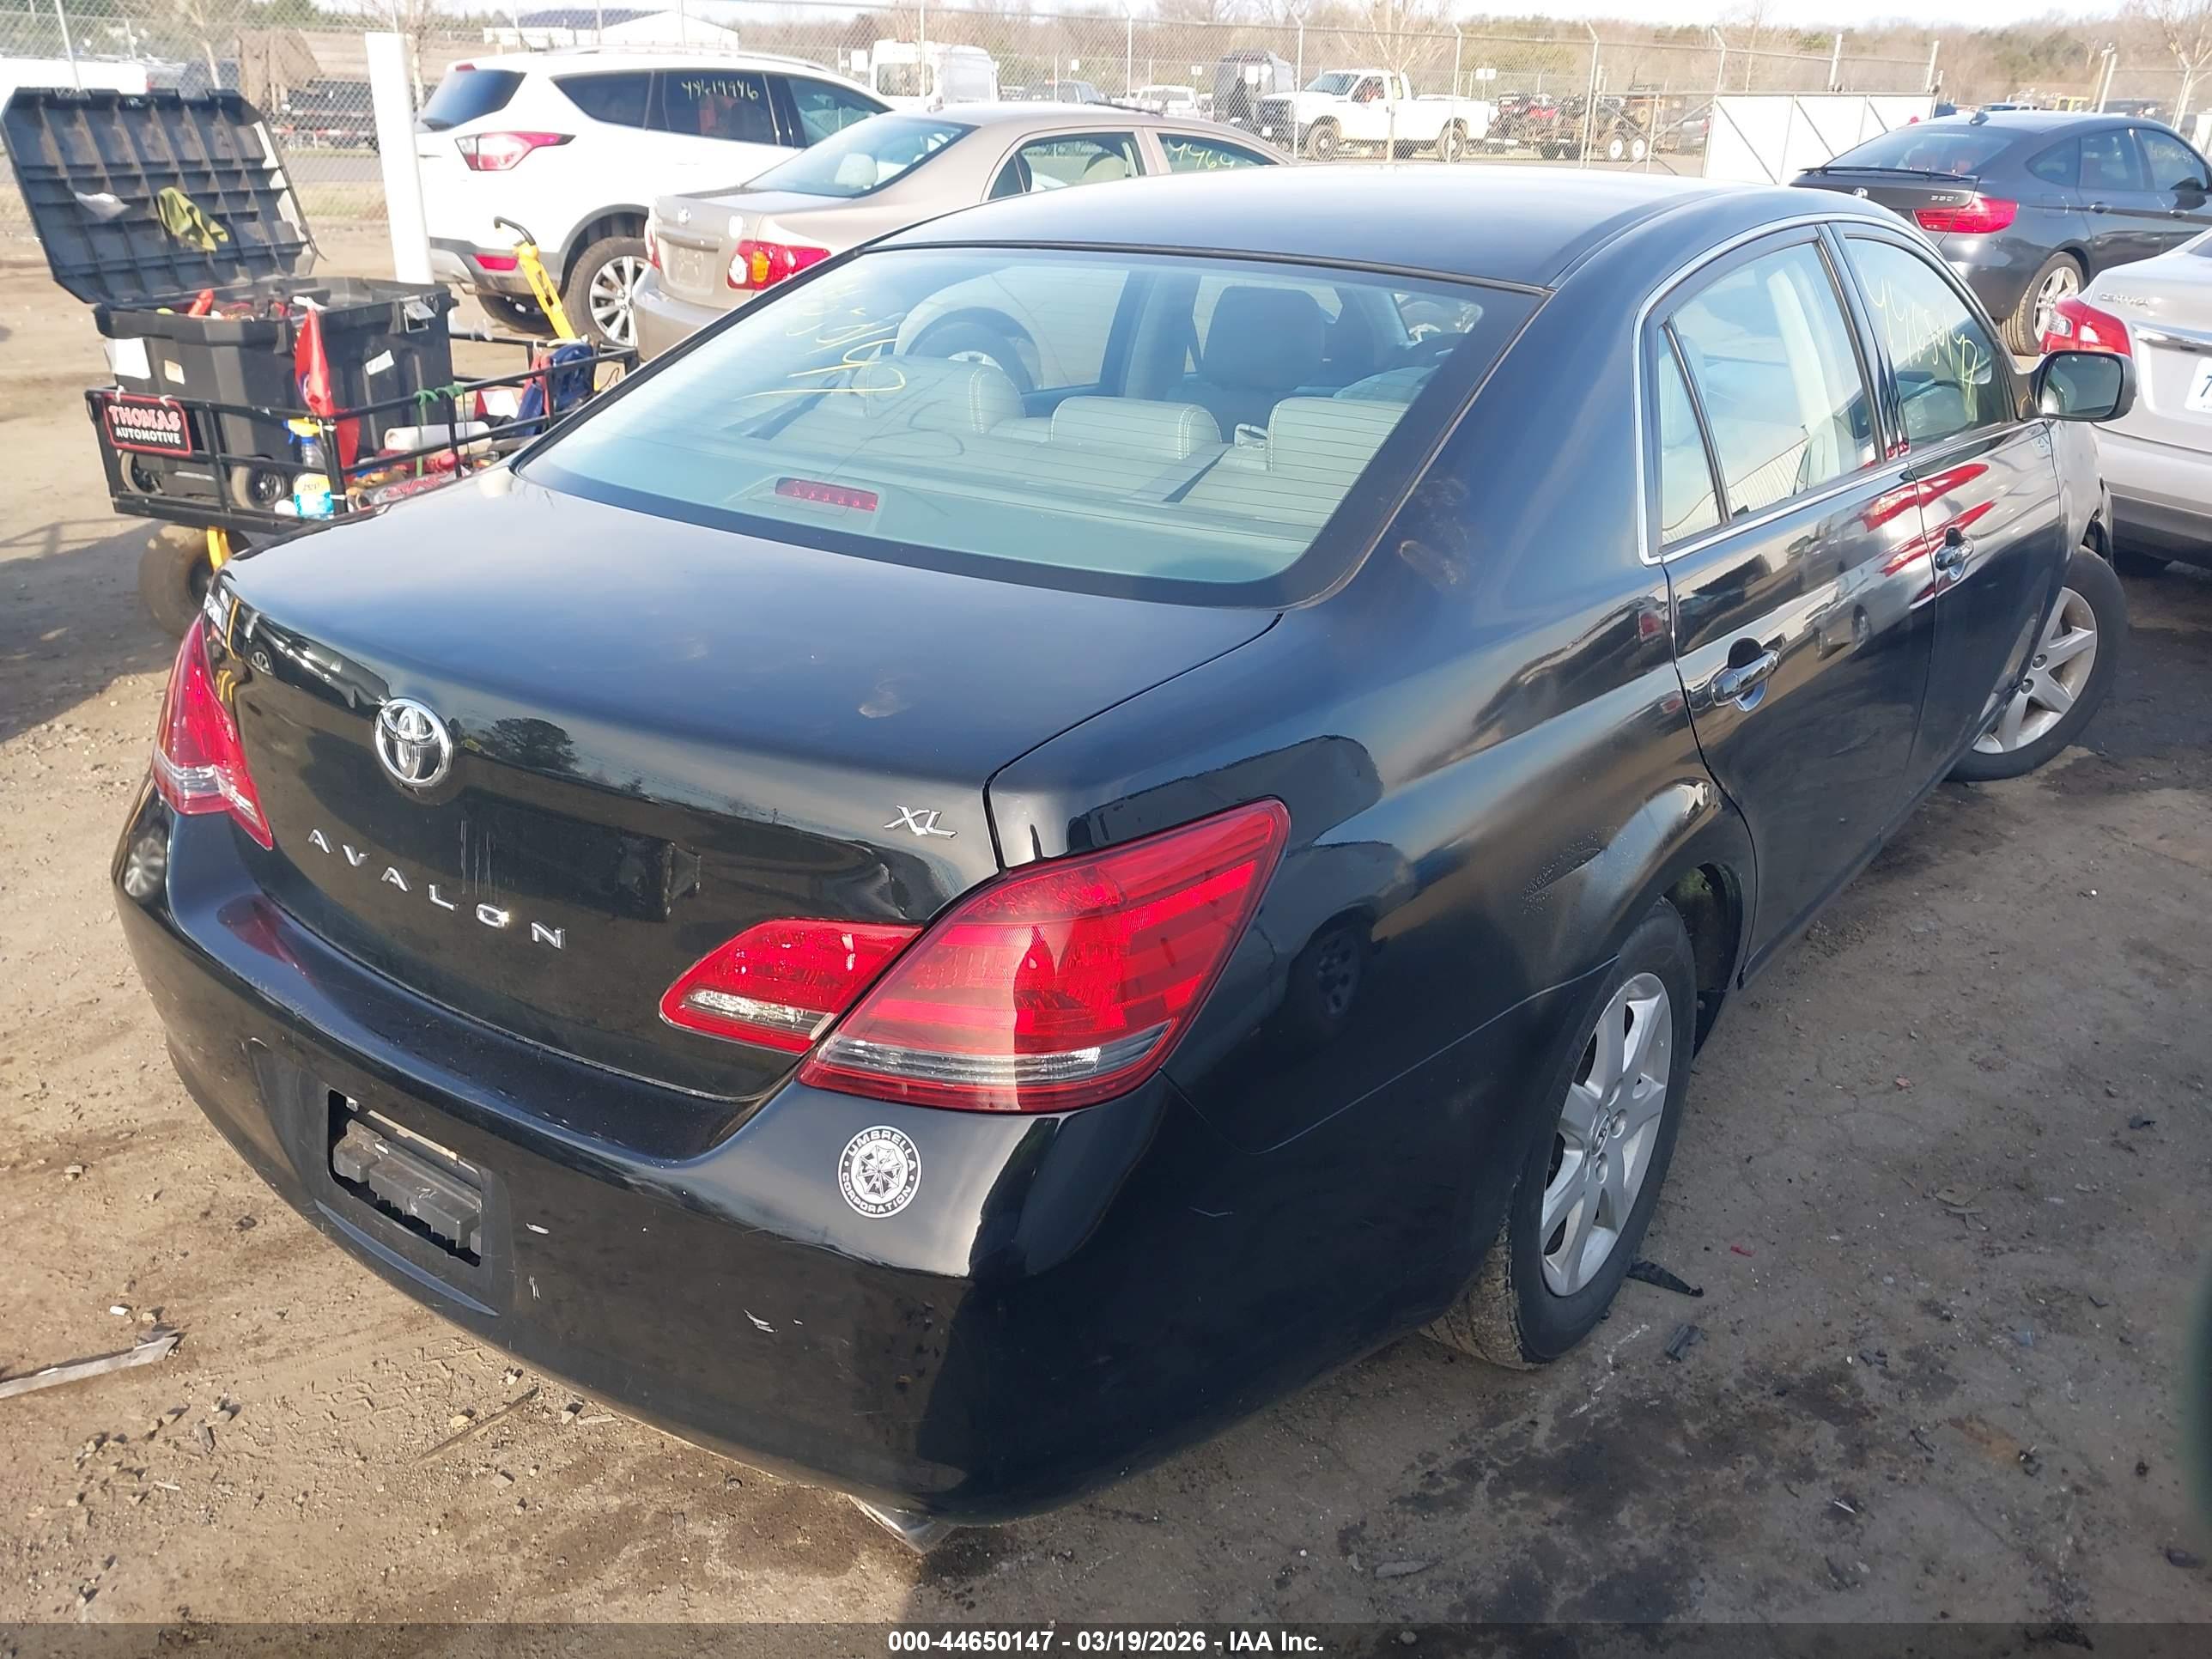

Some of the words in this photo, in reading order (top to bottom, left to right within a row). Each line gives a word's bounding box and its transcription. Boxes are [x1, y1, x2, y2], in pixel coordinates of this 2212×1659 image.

[108, 404, 182, 433] THOMAS
[116, 426, 181, 445] AUTOMOTIVE
[882, 804, 959, 839] XL
[307, 828, 567, 950] AVALON
[847, 1129, 917, 1172] UMBRELLA
[842, 1171, 912, 1214] CORPORATION
